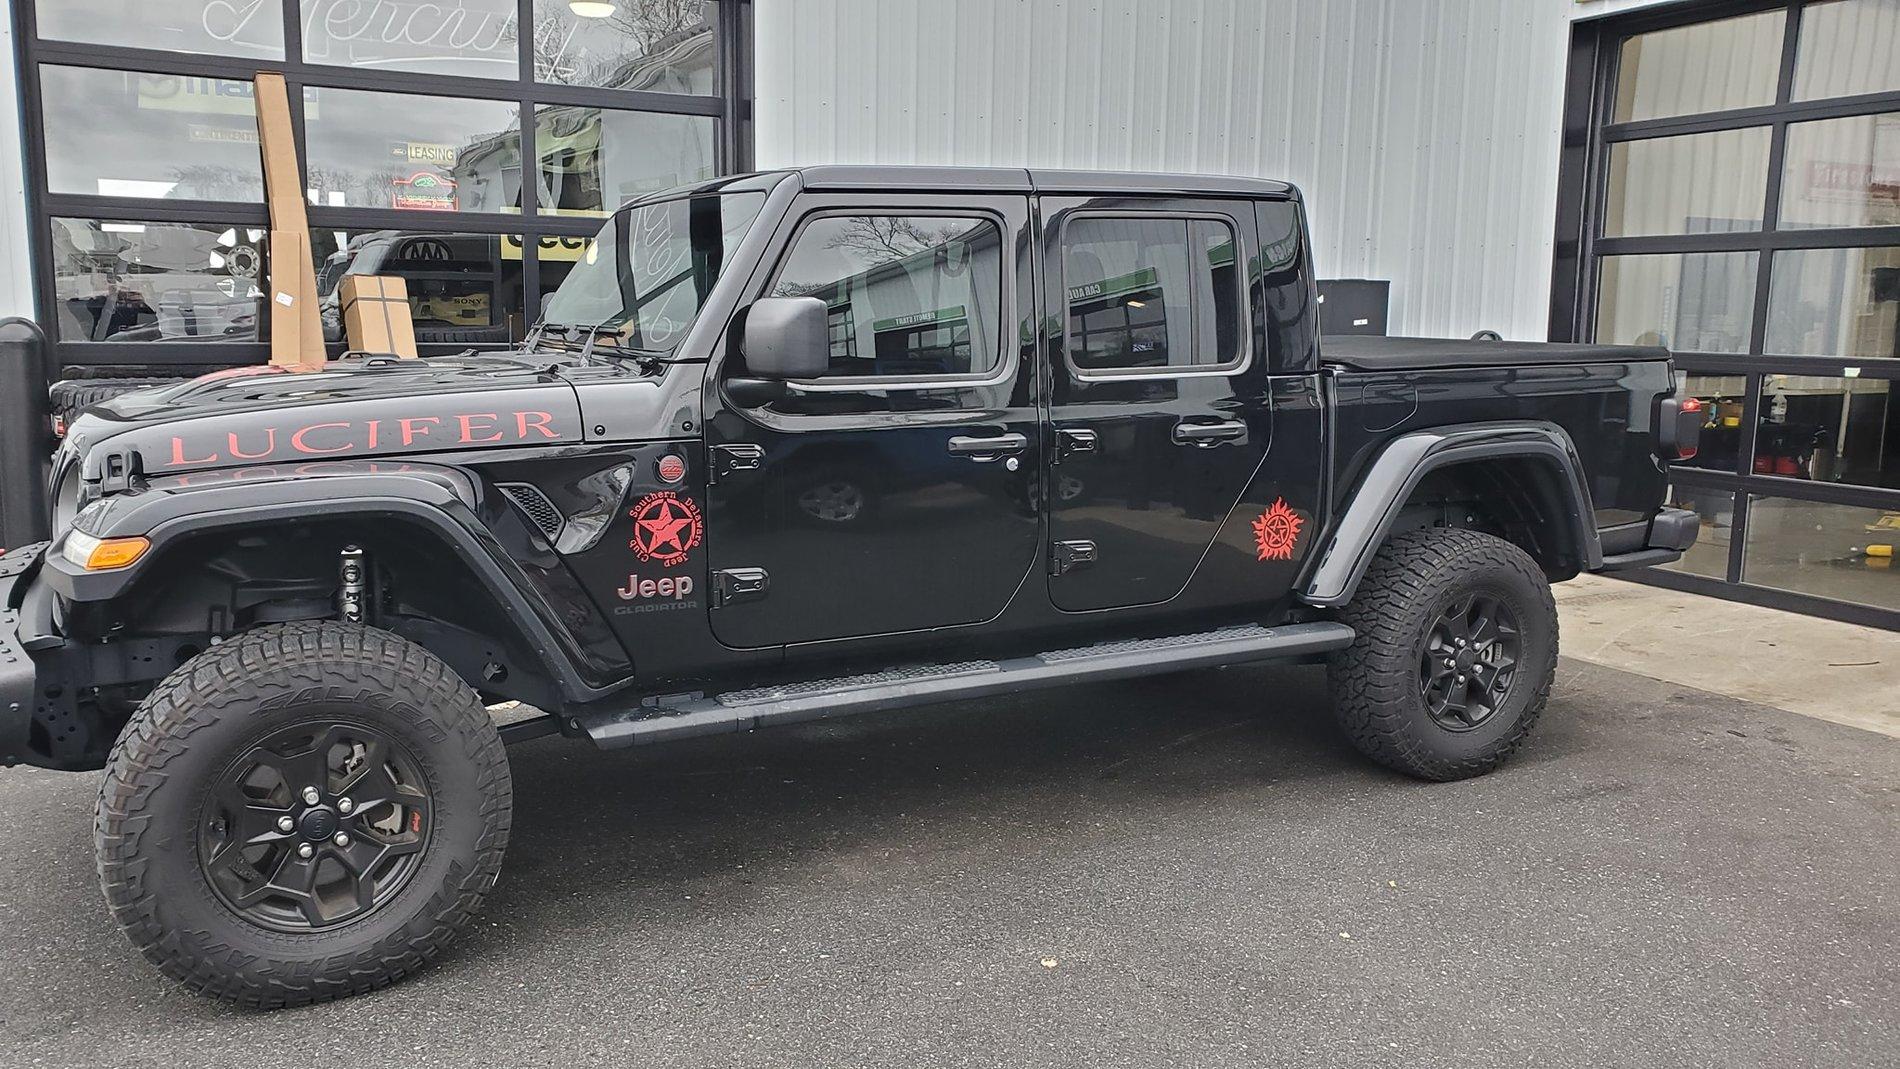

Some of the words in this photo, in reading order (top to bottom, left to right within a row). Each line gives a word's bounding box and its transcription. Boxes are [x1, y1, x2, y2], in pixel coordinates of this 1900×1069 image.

[409, 146, 454, 161] LEASING
[164, 411, 561, 465] LUCIFER
[629, 491, 677, 518] Southern
[684, 497, 704, 547] Delaware
[629, 538, 650, 563] Club
[663, 552, 689, 568] Jeep
[617, 574, 693, 600] Jeep
[614, 601, 697, 615] GLADIATOR
